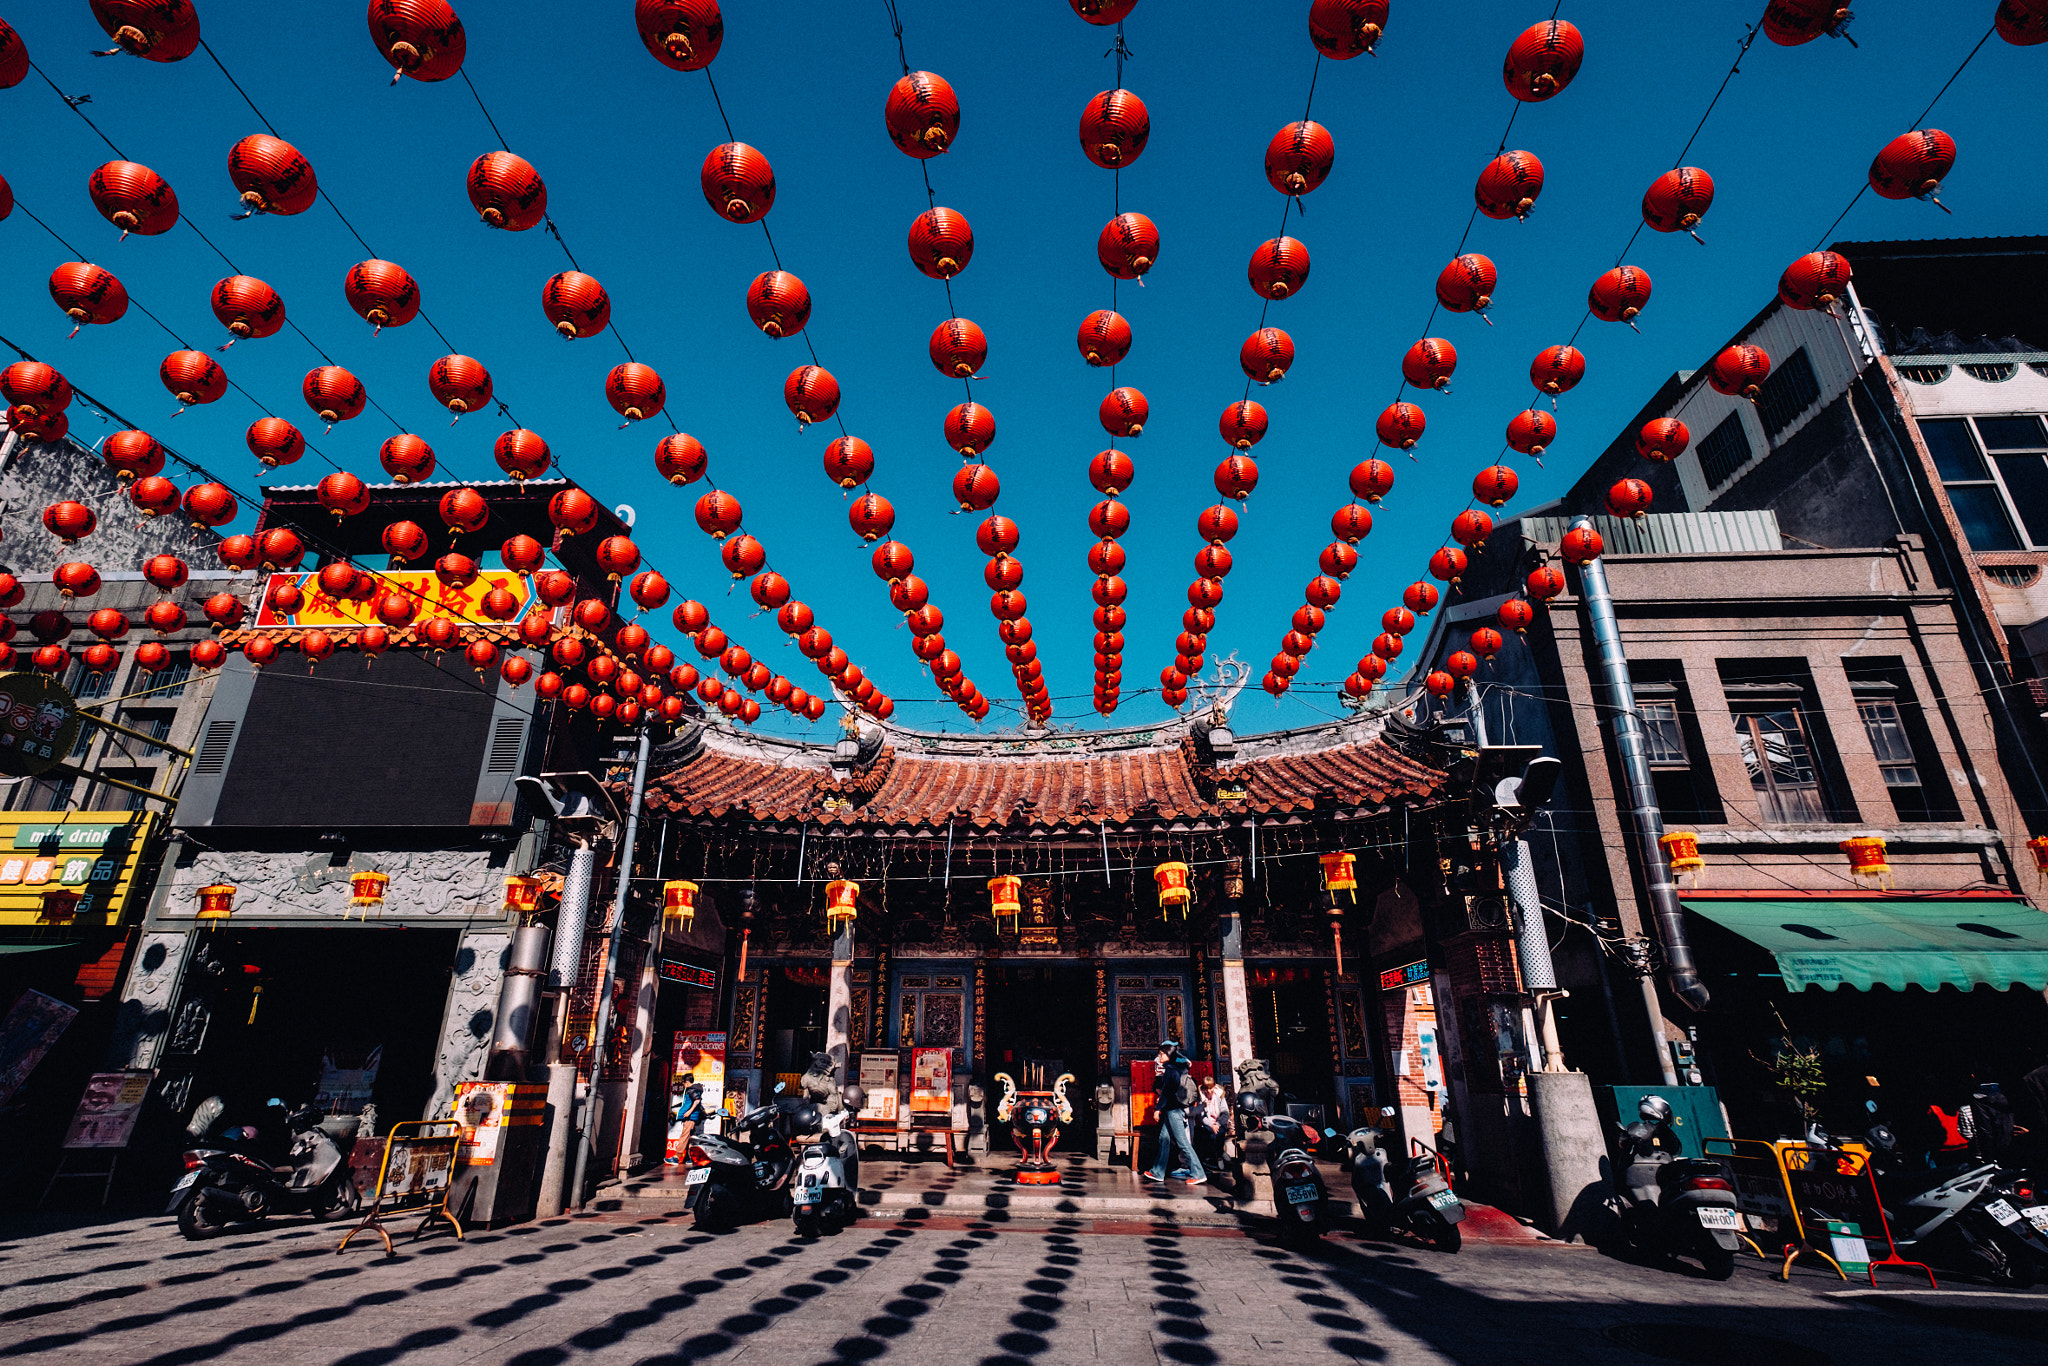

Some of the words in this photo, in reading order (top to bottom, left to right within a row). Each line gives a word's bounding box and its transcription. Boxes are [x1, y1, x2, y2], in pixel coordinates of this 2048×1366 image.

[29, 829, 65, 843] milk
[69, 829, 111, 843] drink
[1, 859, 115, 881] 健康飲品
